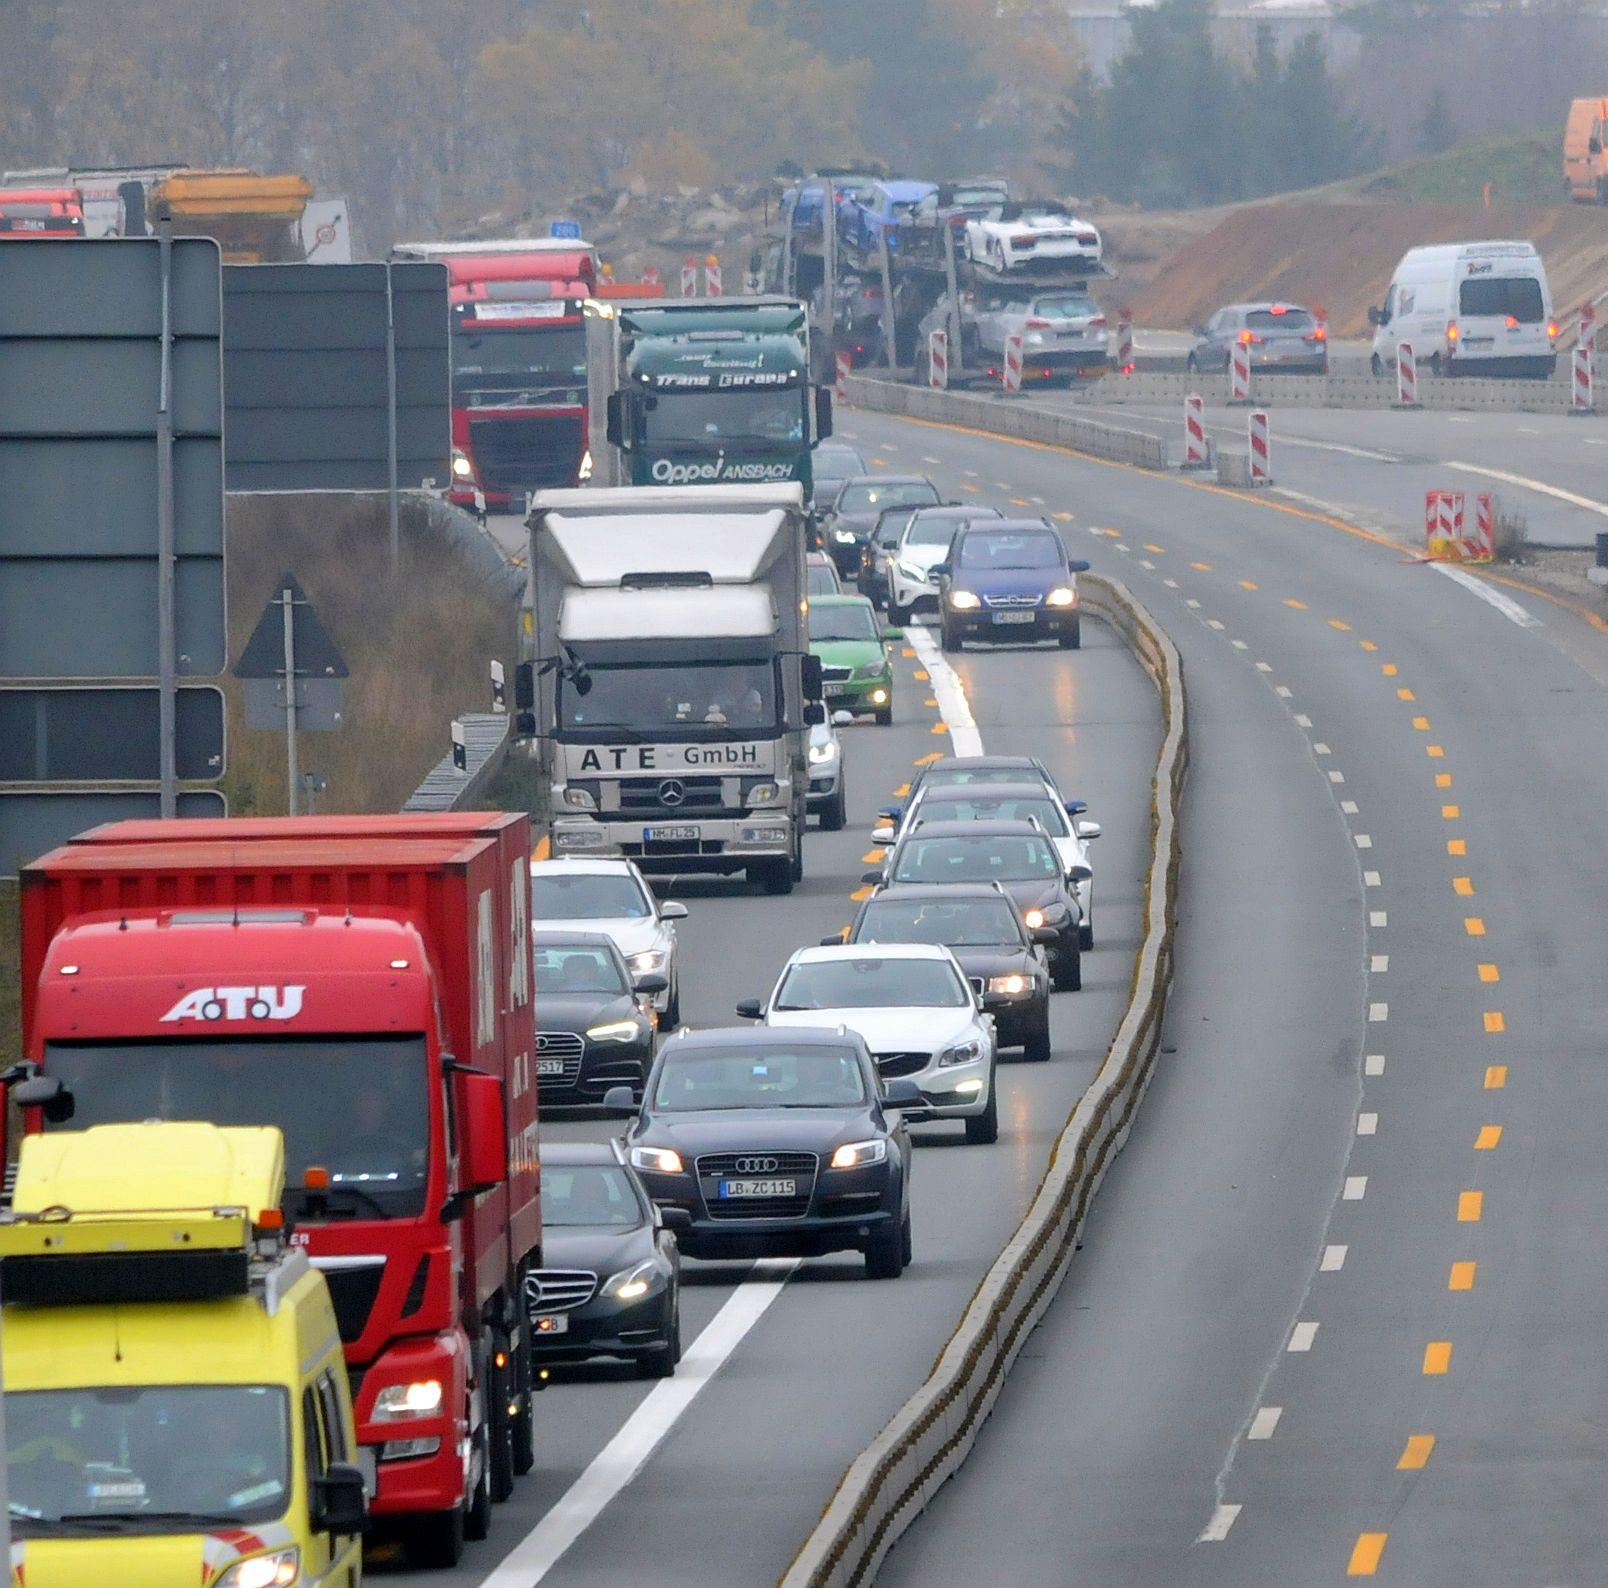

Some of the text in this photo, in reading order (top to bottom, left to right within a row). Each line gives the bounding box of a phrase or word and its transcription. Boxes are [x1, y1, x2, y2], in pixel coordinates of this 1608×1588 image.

[656, 373, 710, 387] Trans
[651, 449, 793, 485] Oppel ANSBACH
[580, 745, 757, 771] ATE GmbH
[158, 984, 308, 1023] ATU
[771, 1181, 795, 1194] 115
[289, 1232, 310, 1246] ER
